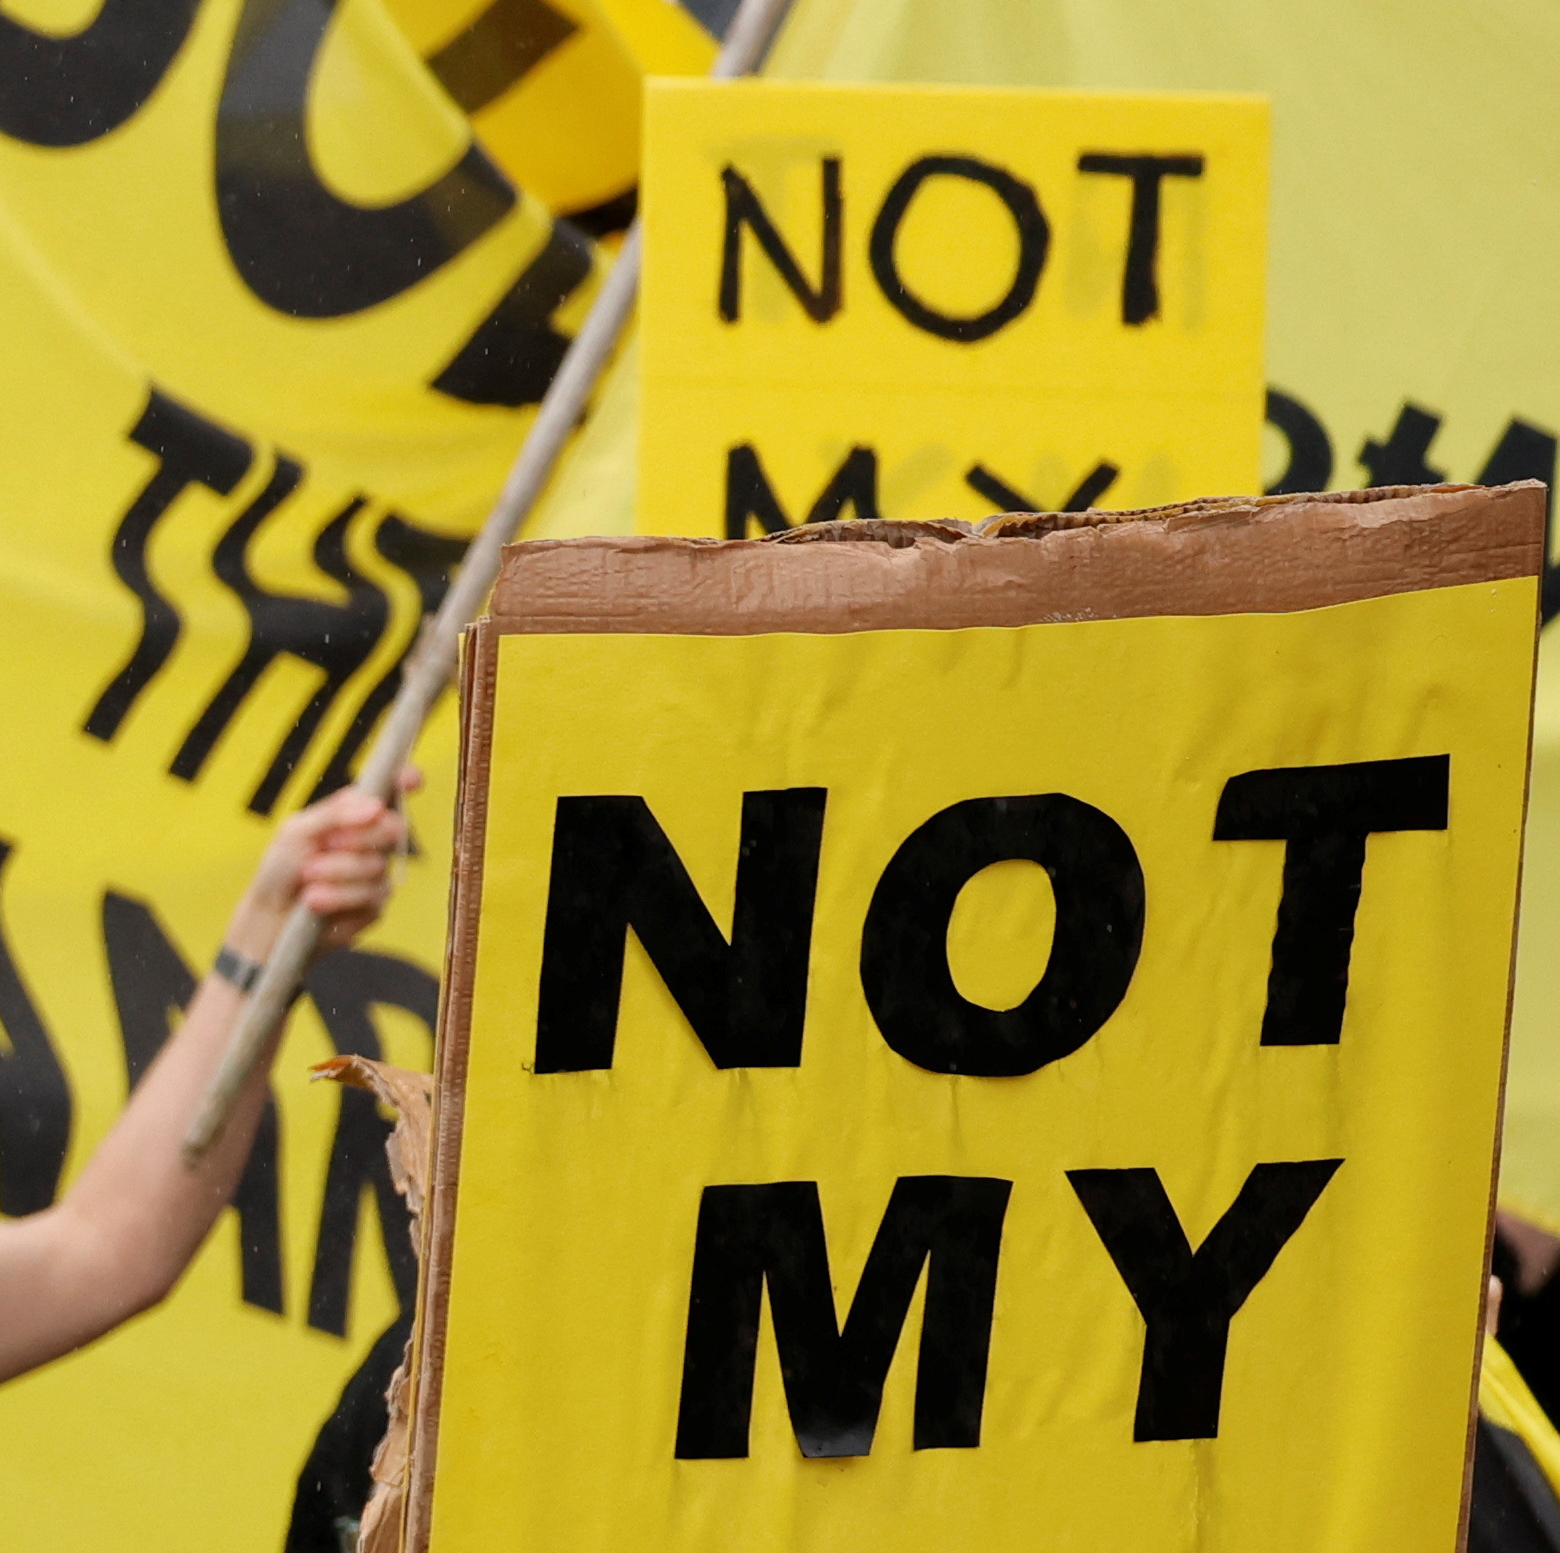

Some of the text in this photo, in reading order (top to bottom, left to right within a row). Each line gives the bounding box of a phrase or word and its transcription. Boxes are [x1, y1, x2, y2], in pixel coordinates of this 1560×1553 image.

[719, 152, 1206, 343] NOT
[534, 753, 1450, 1078] NOT
[674, 1158, 1346, 1460] MY
